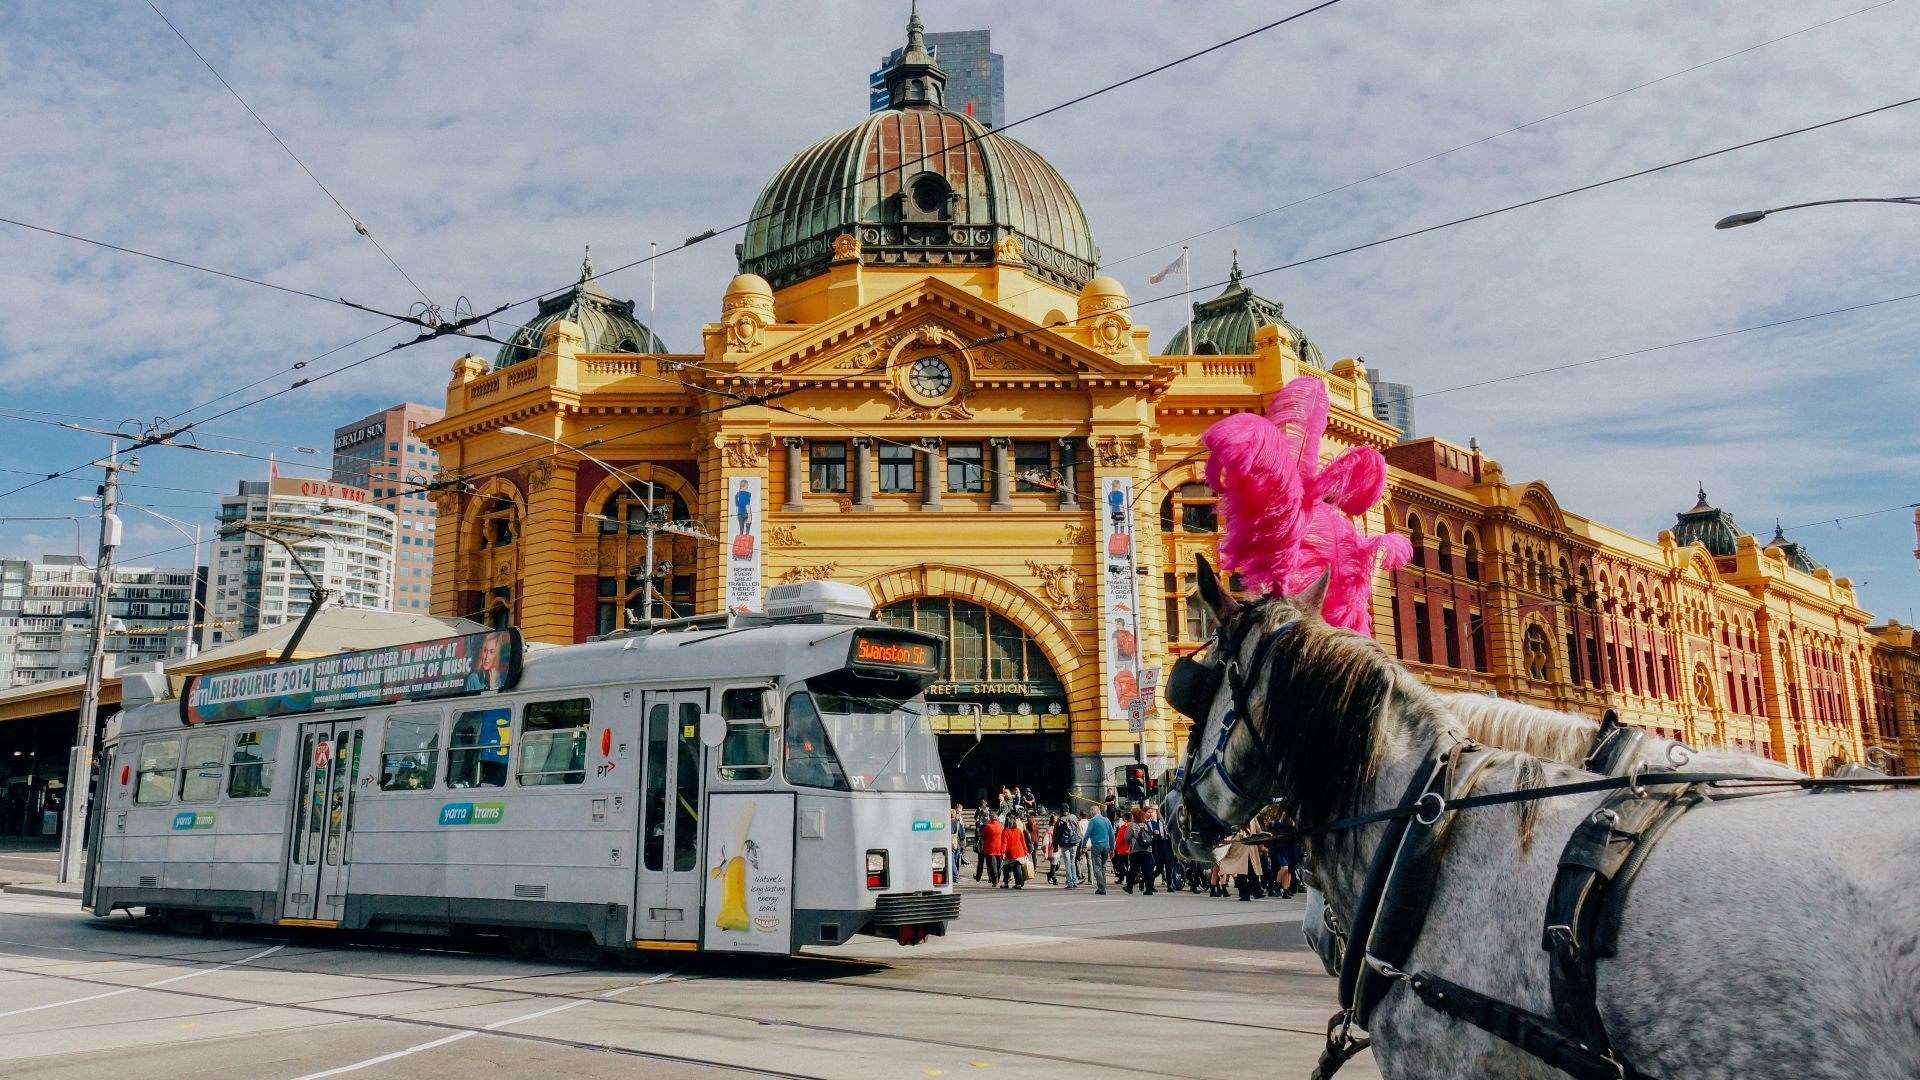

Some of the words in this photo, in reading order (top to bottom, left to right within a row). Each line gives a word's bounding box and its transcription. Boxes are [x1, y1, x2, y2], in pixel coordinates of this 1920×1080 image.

[366, 422, 384, 438] SUN
[301, 482, 334, 497] QUAY
[342, 487, 366, 503] WEST
[316, 659, 341, 676] START
[342, 656, 364, 672] YOUR
[367, 652, 399, 668] CAREER
[401, 651, 412, 664] IN
[414, 645, 443, 662] MUSIC
[444, 642, 458, 658] AT
[858, 639, 910, 662] Swanston
[912, 646, 925, 664] St
[315, 677, 329, 692] THE
[331, 670, 382, 688] AUSTRALIAN
[384, 664, 424, 682] INSTITUTE
[428, 662, 440, 676] OF
[442, 657, 472, 676] MUSIC
[189, 680, 208, 708] aim
[210, 673, 278, 700] MELBOURNE
[282, 668, 311, 692] 2014
[974, 684, 1027, 694] STATION
[921, 774, 941, 791] 167
[444, 808, 467, 823] yarra
[474, 806, 500, 818] trams
[754, 874, 782, 882] Nature's
[750, 886, 764, 895] long
[764, 884, 786, 895] lasting
[758, 896, 778, 905] energy
